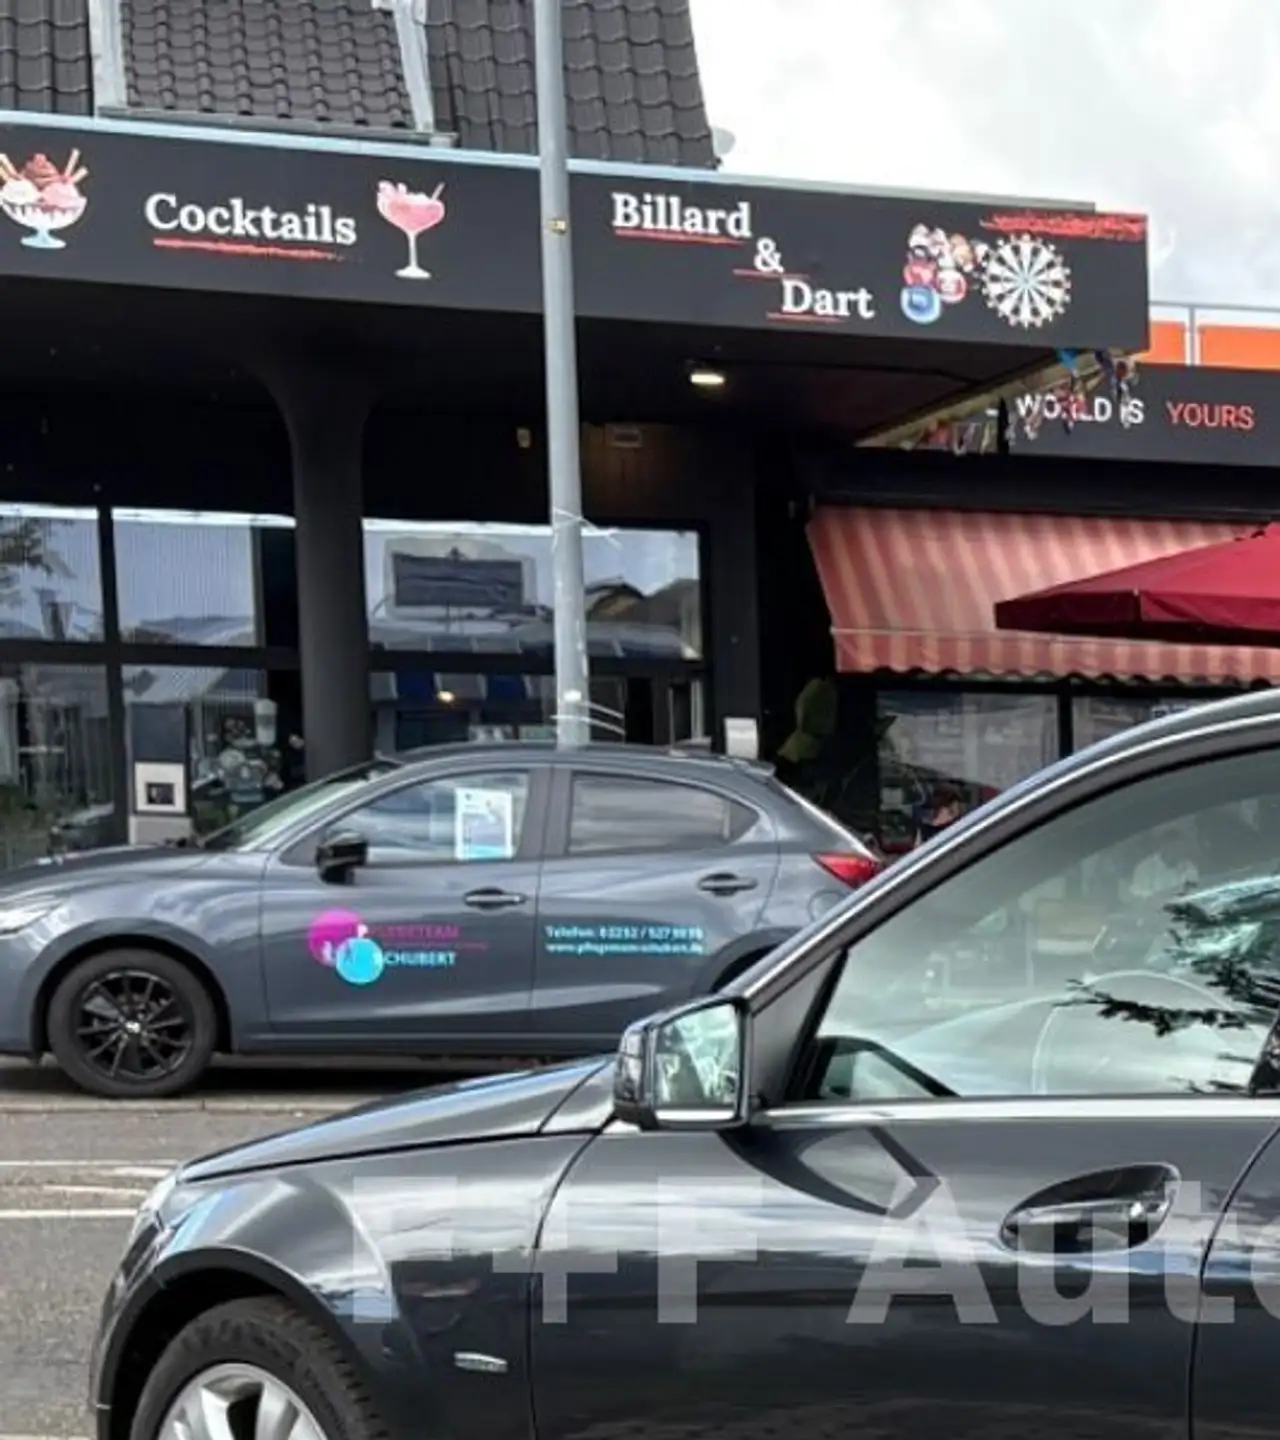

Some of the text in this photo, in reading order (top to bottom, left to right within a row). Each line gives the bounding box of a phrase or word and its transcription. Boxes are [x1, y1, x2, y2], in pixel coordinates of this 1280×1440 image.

[144, 192, 358, 246] Cocktails
[611, 192, 752, 239] Billard
[753, 236, 785, 274] &
[781, 279, 874, 320] Dart
[1166, 401, 1256, 431] YOURS
